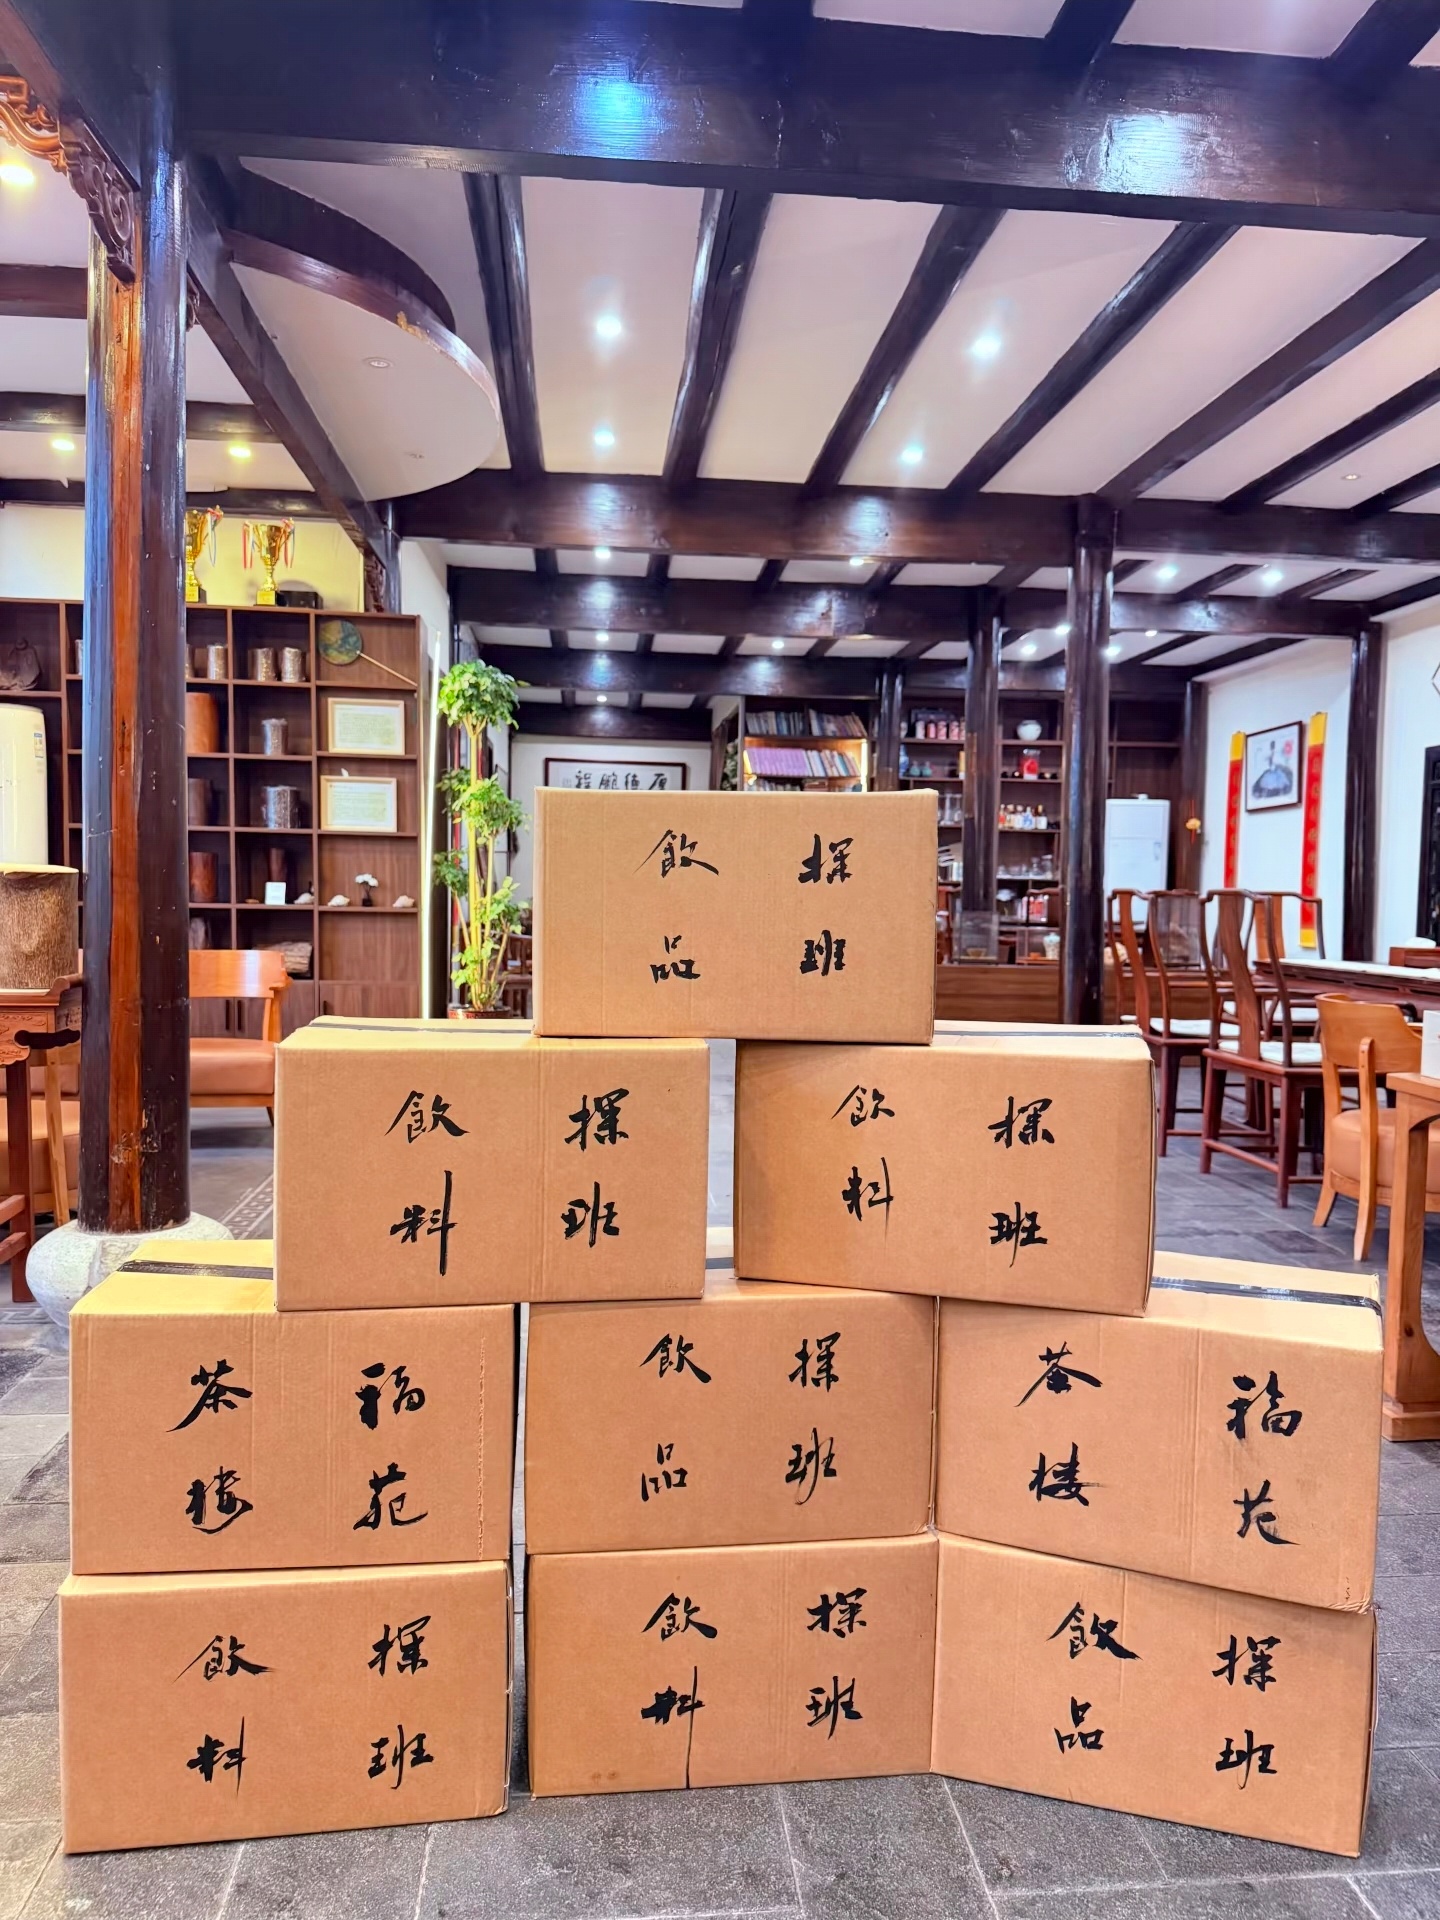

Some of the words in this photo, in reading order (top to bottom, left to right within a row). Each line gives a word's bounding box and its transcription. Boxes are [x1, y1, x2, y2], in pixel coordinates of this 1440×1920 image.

[798, 834, 854, 976] 探班
[562, 1088, 629, 1248] 探班
[988, 1096, 1055, 1267] 探班
[785, 1332, 841, 1505] 探班
[368, 1616, 434, 1789] 探班
[806, 1588, 868, 1739] 探班
[1212, 1635, 1281, 1790] 探班
